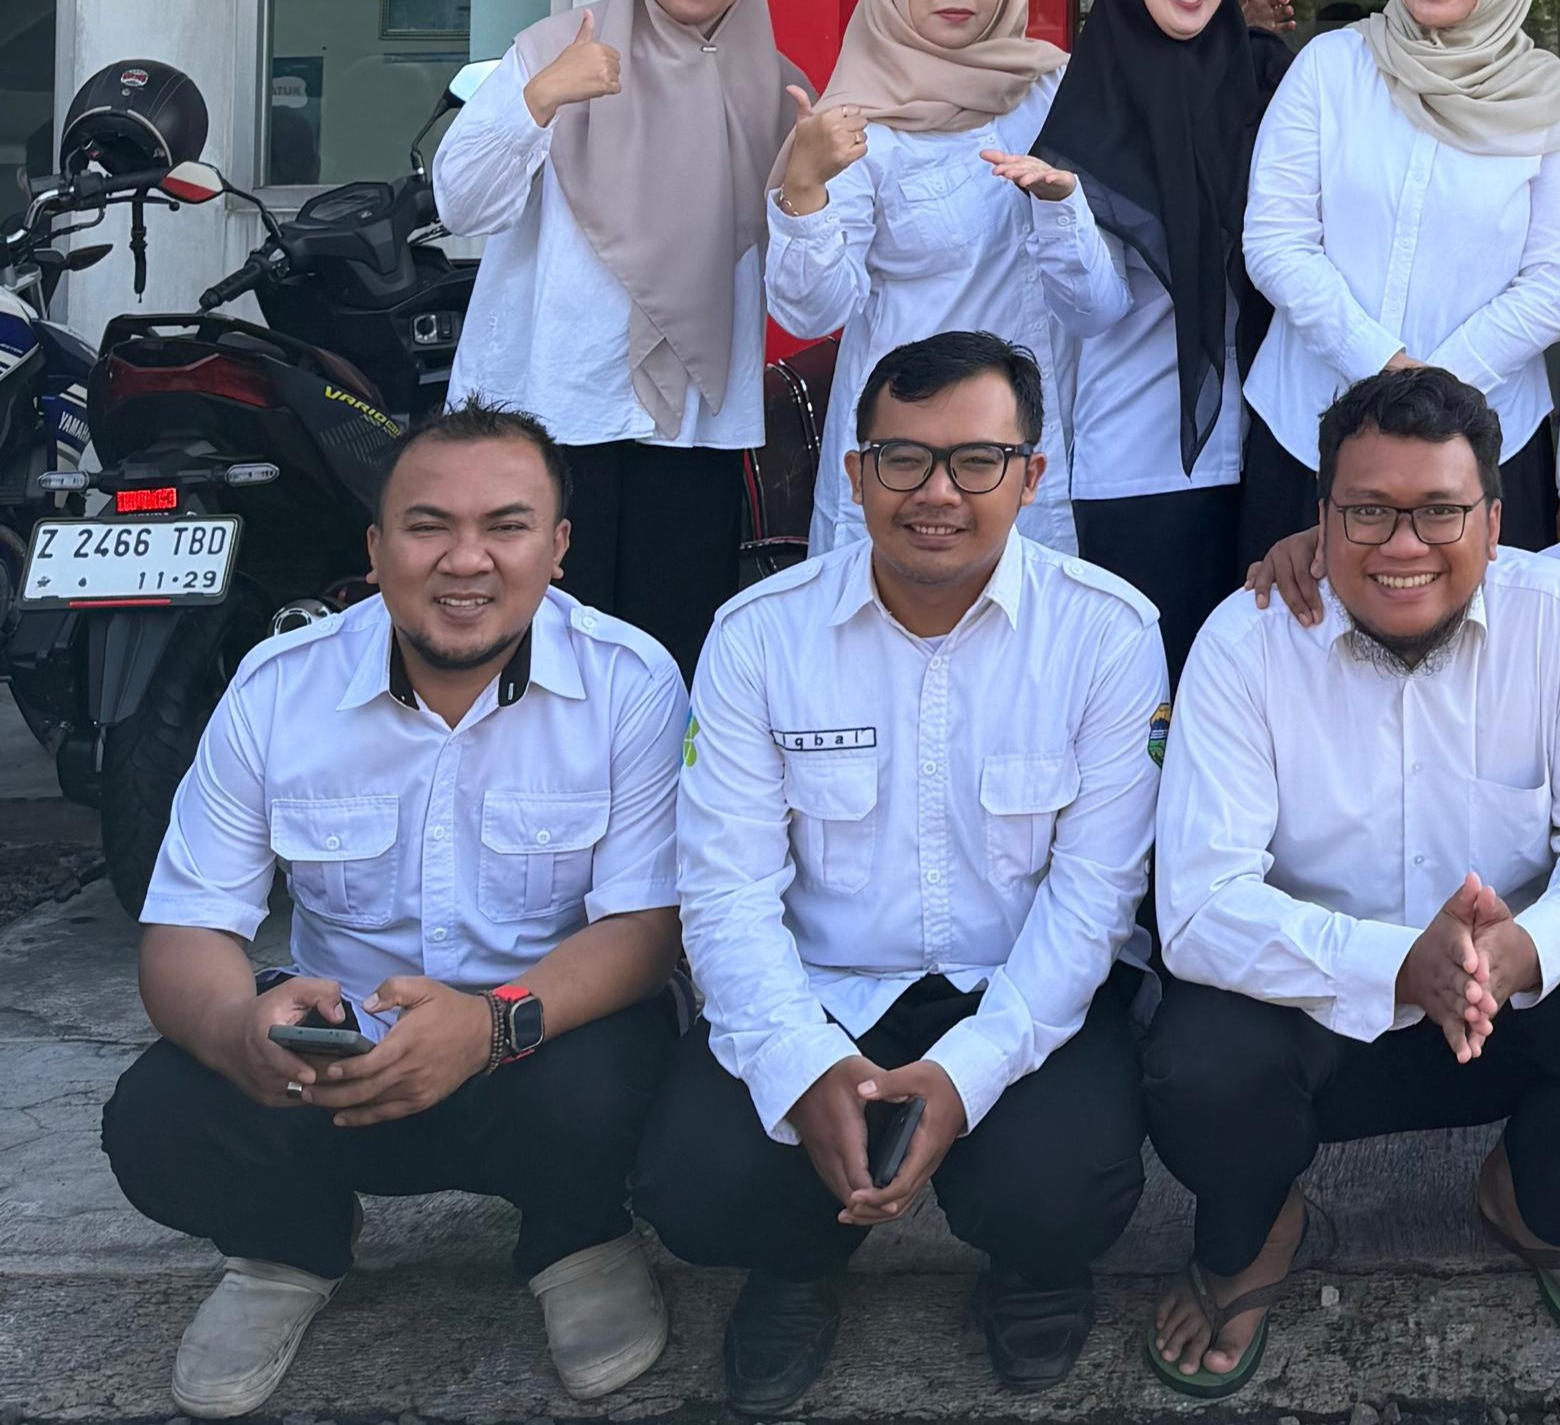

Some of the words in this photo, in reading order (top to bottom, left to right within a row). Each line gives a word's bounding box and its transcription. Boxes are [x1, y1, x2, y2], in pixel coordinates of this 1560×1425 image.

[325, 386, 387, 424] VARIO
[37, 529, 59, 559] Z
[73, 528, 152, 558] 2466
[173, 526, 227, 556] TBD
